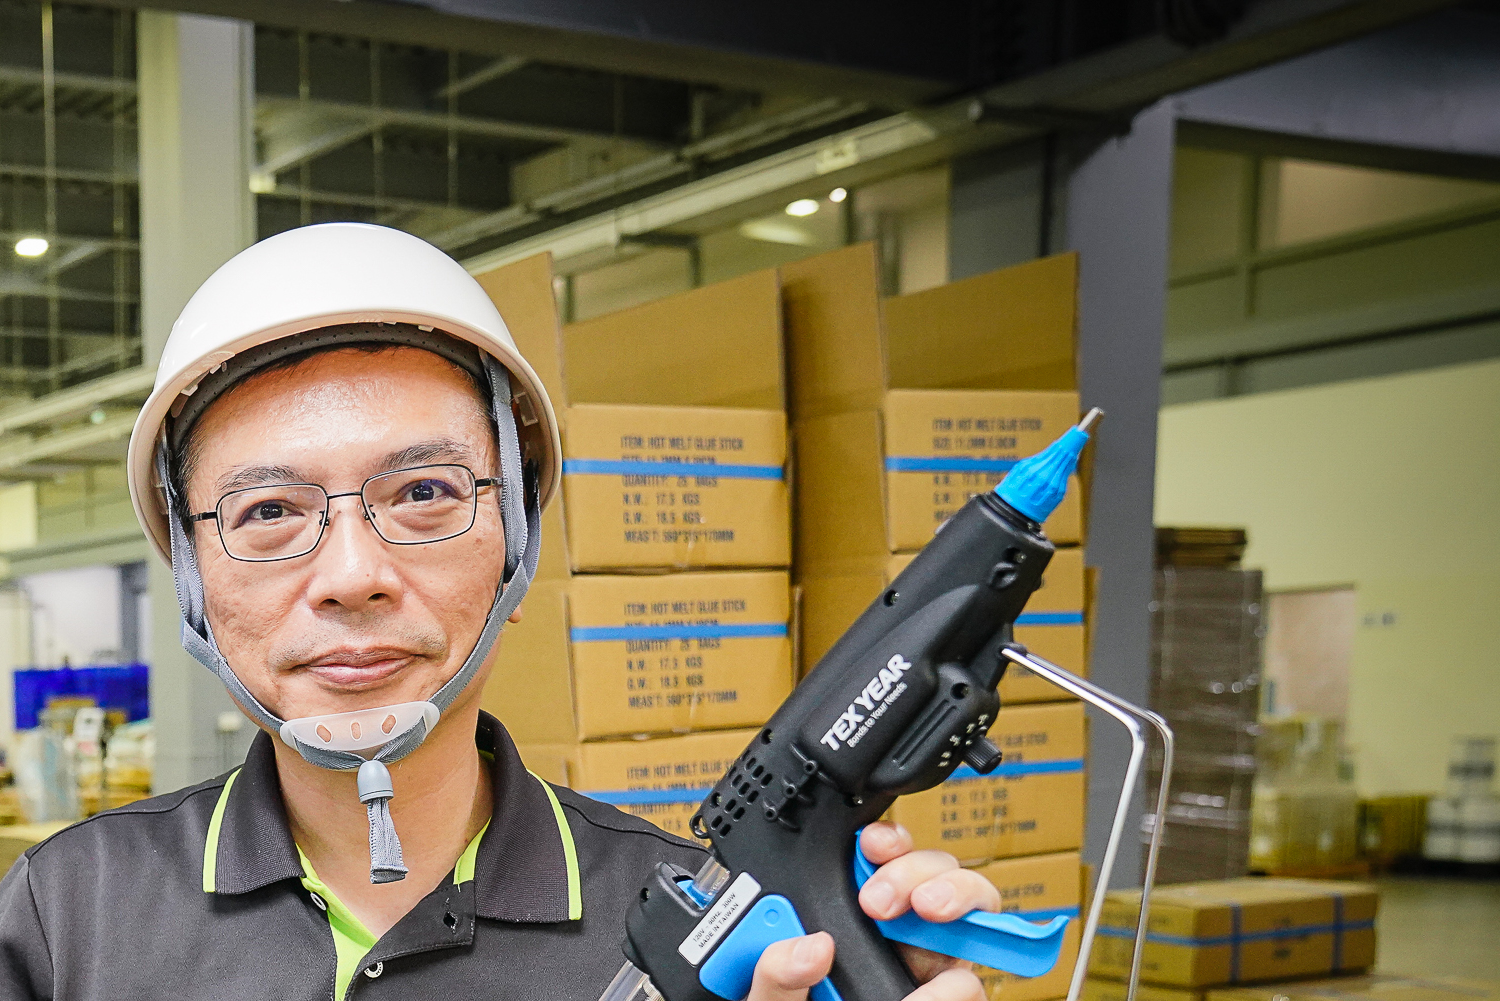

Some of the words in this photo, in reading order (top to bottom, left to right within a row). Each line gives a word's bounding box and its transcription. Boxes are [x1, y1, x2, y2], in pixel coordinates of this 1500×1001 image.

[820, 703, 865, 751] TEX
[854, 653, 912, 711] YEAR
[846, 725, 869, 748] Bonds
[865, 717, 875, 728] to
[870, 702, 889, 719] Your
[884, 682, 908, 705] Needs
[698, 931, 715, 949] MADE
[713, 924, 720, 933] IN
[718, 903, 739, 925] TAIWAN
